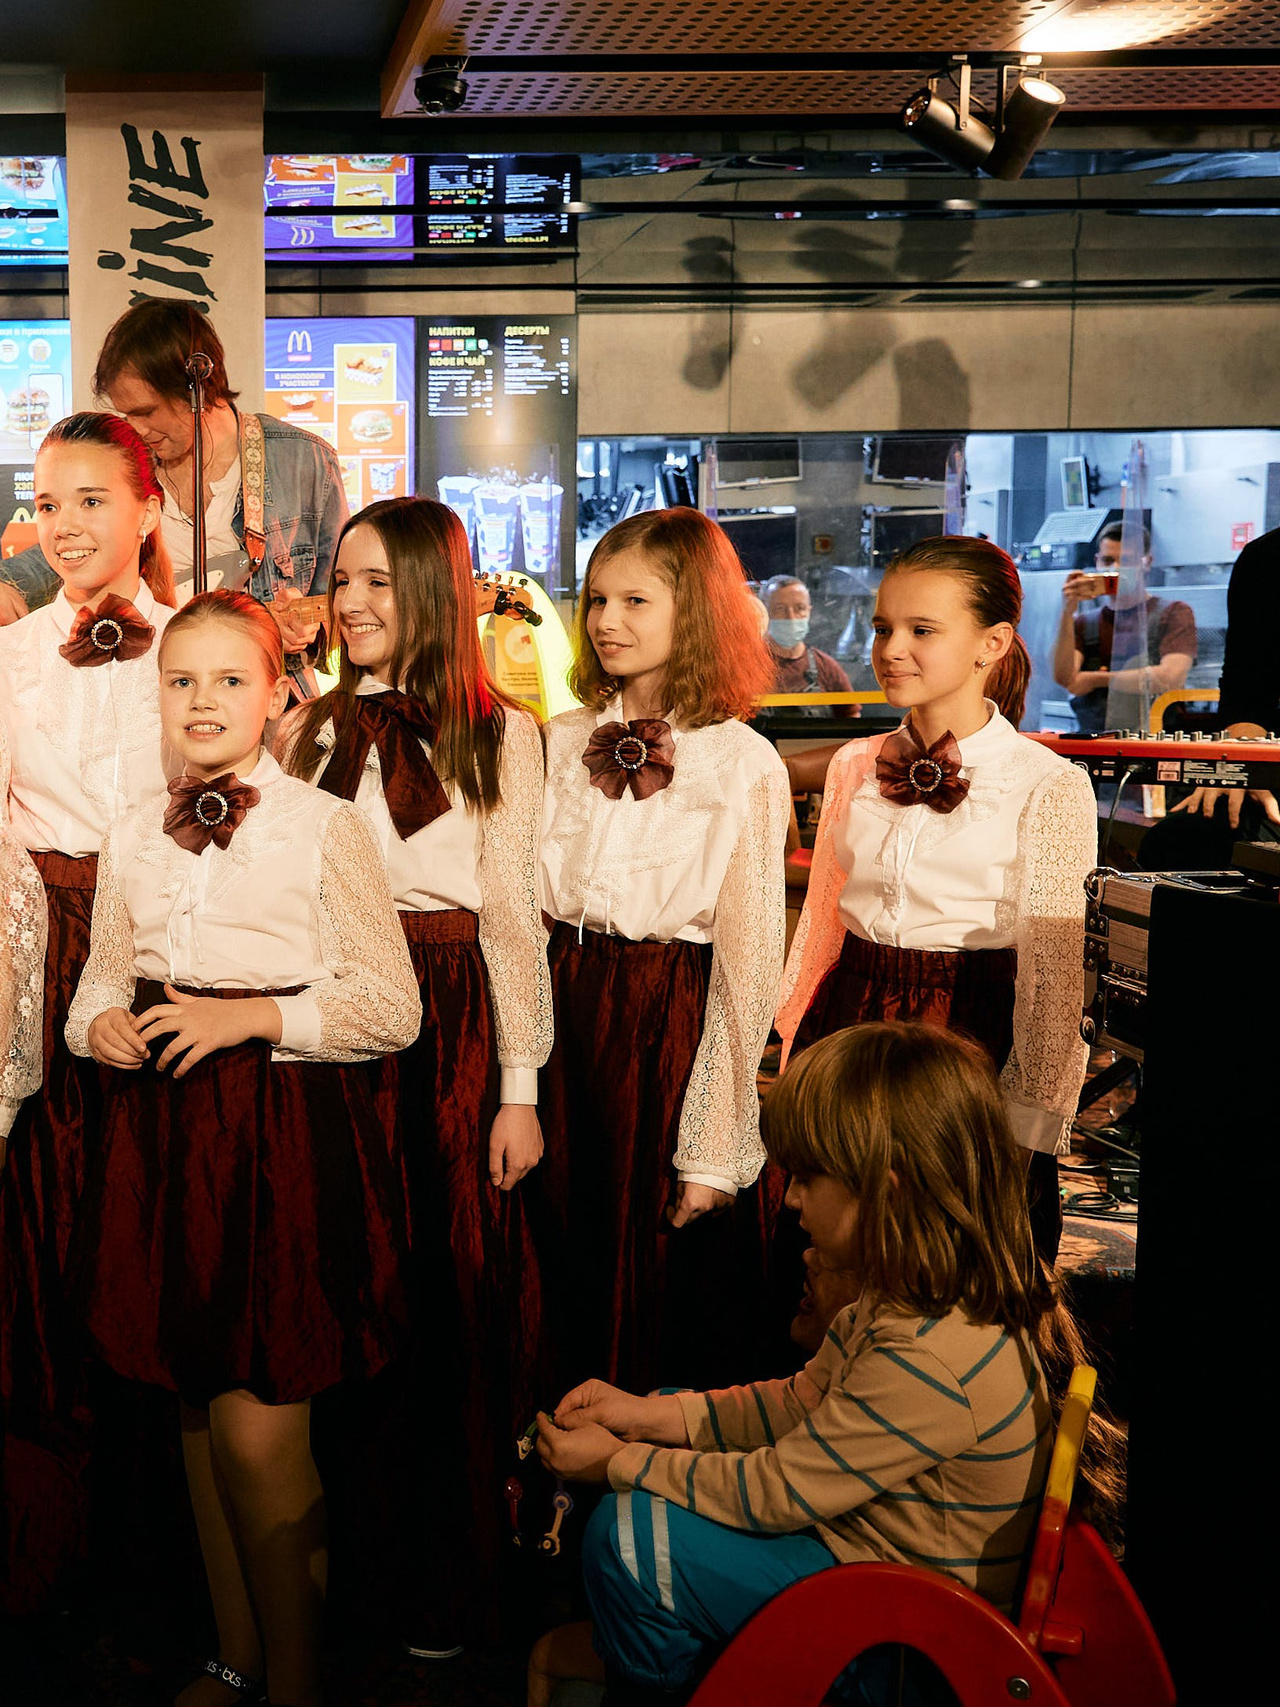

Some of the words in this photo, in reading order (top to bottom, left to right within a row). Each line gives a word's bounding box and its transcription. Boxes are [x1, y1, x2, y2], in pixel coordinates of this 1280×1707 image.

[429, 327, 475, 336] НАПИТКИ
[504, 326, 550, 337] ДЕСЕРТЫ
[429, 357, 456, 366] КОФЕ
[457, 357, 464, 366] И
[465, 354, 485, 366] ЧАЙ
[222, 1667, 242, 1687] bts
